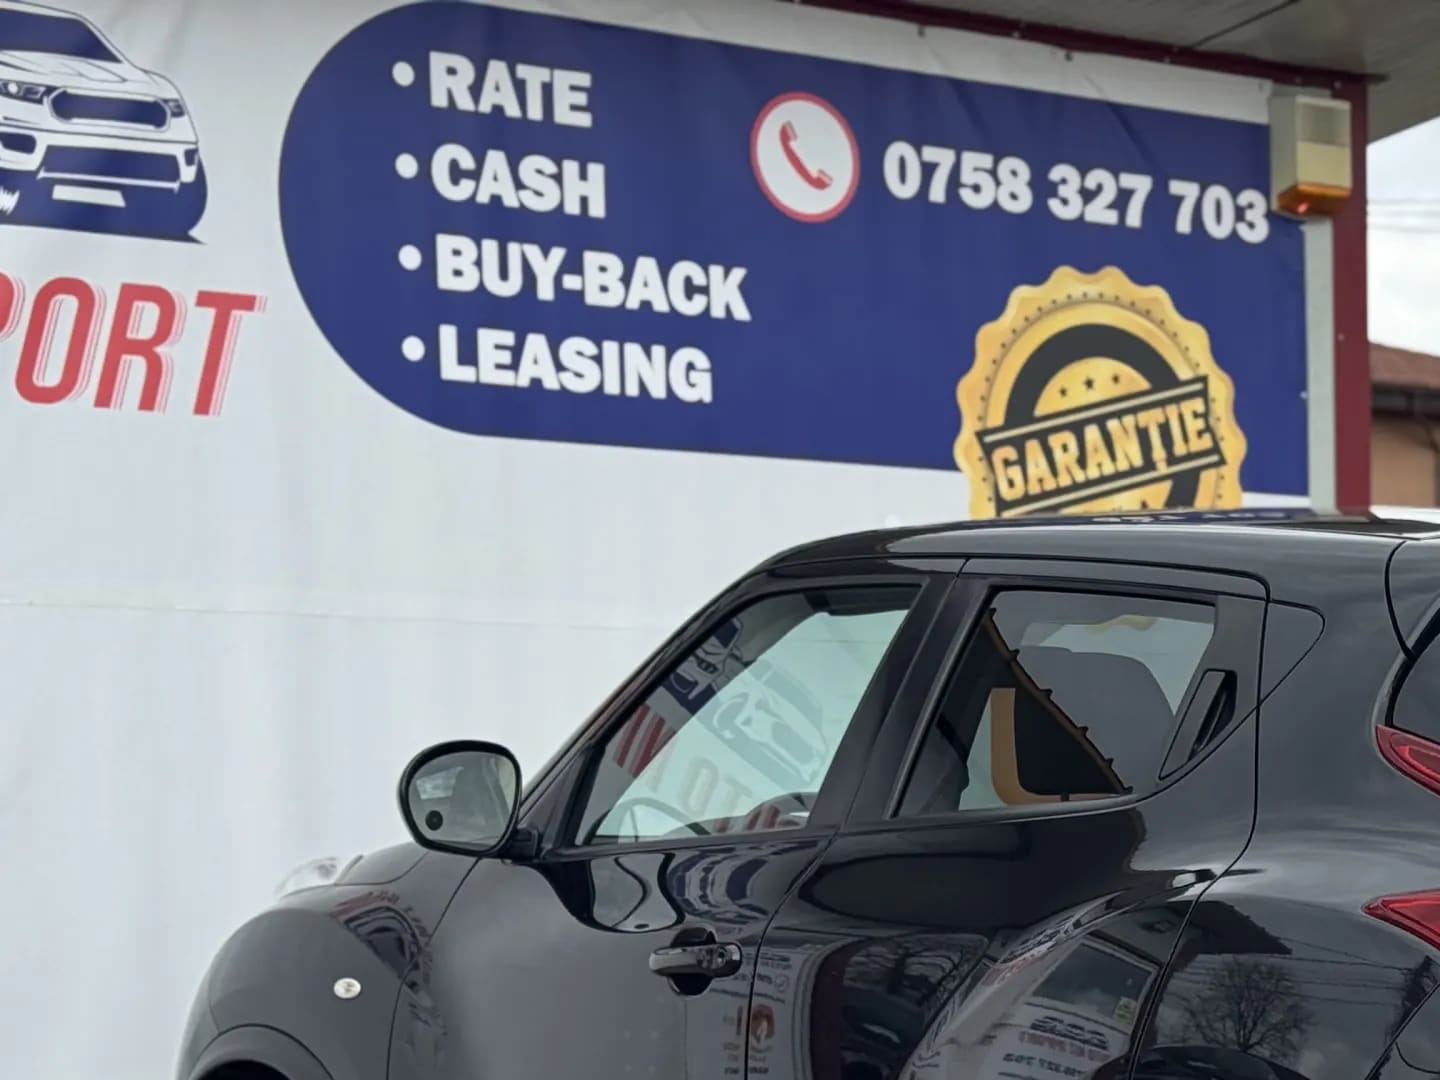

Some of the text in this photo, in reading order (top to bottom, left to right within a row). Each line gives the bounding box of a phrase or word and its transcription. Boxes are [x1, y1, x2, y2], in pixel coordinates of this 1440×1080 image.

[429, 50, 593, 128] RATE
[430, 142, 606, 219] CASH
[882, 140, 1270, 244] 0758 327 703
[435, 233, 752, 322] BUY-BACK
[439, 323, 714, 404] LEASING
